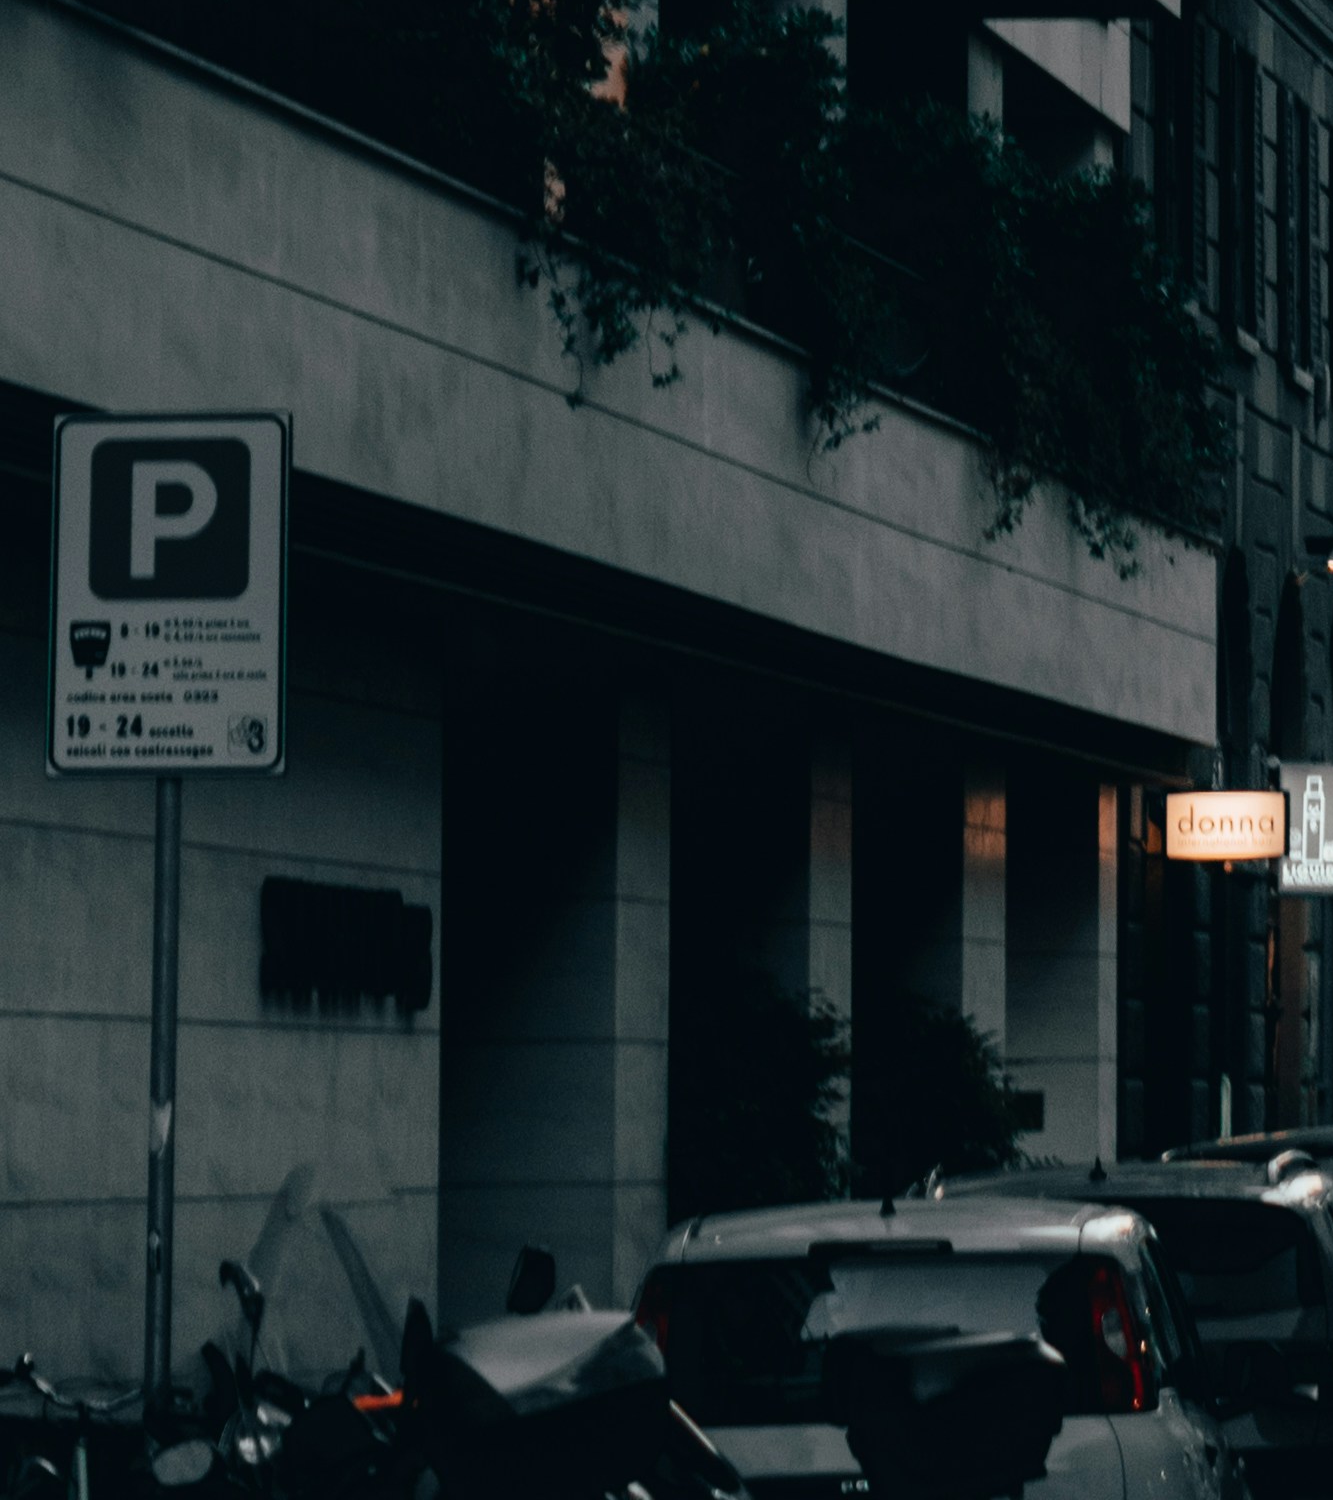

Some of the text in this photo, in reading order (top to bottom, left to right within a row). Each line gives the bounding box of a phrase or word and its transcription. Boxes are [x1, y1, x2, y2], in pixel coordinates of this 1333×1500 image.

[129, 460, 219, 580] P
[142, 662, 159, 678] 24
[66, 714, 91, 739] 19
[116, 714, 143, 739] 24
[1178, 804, 1275, 835] donna
